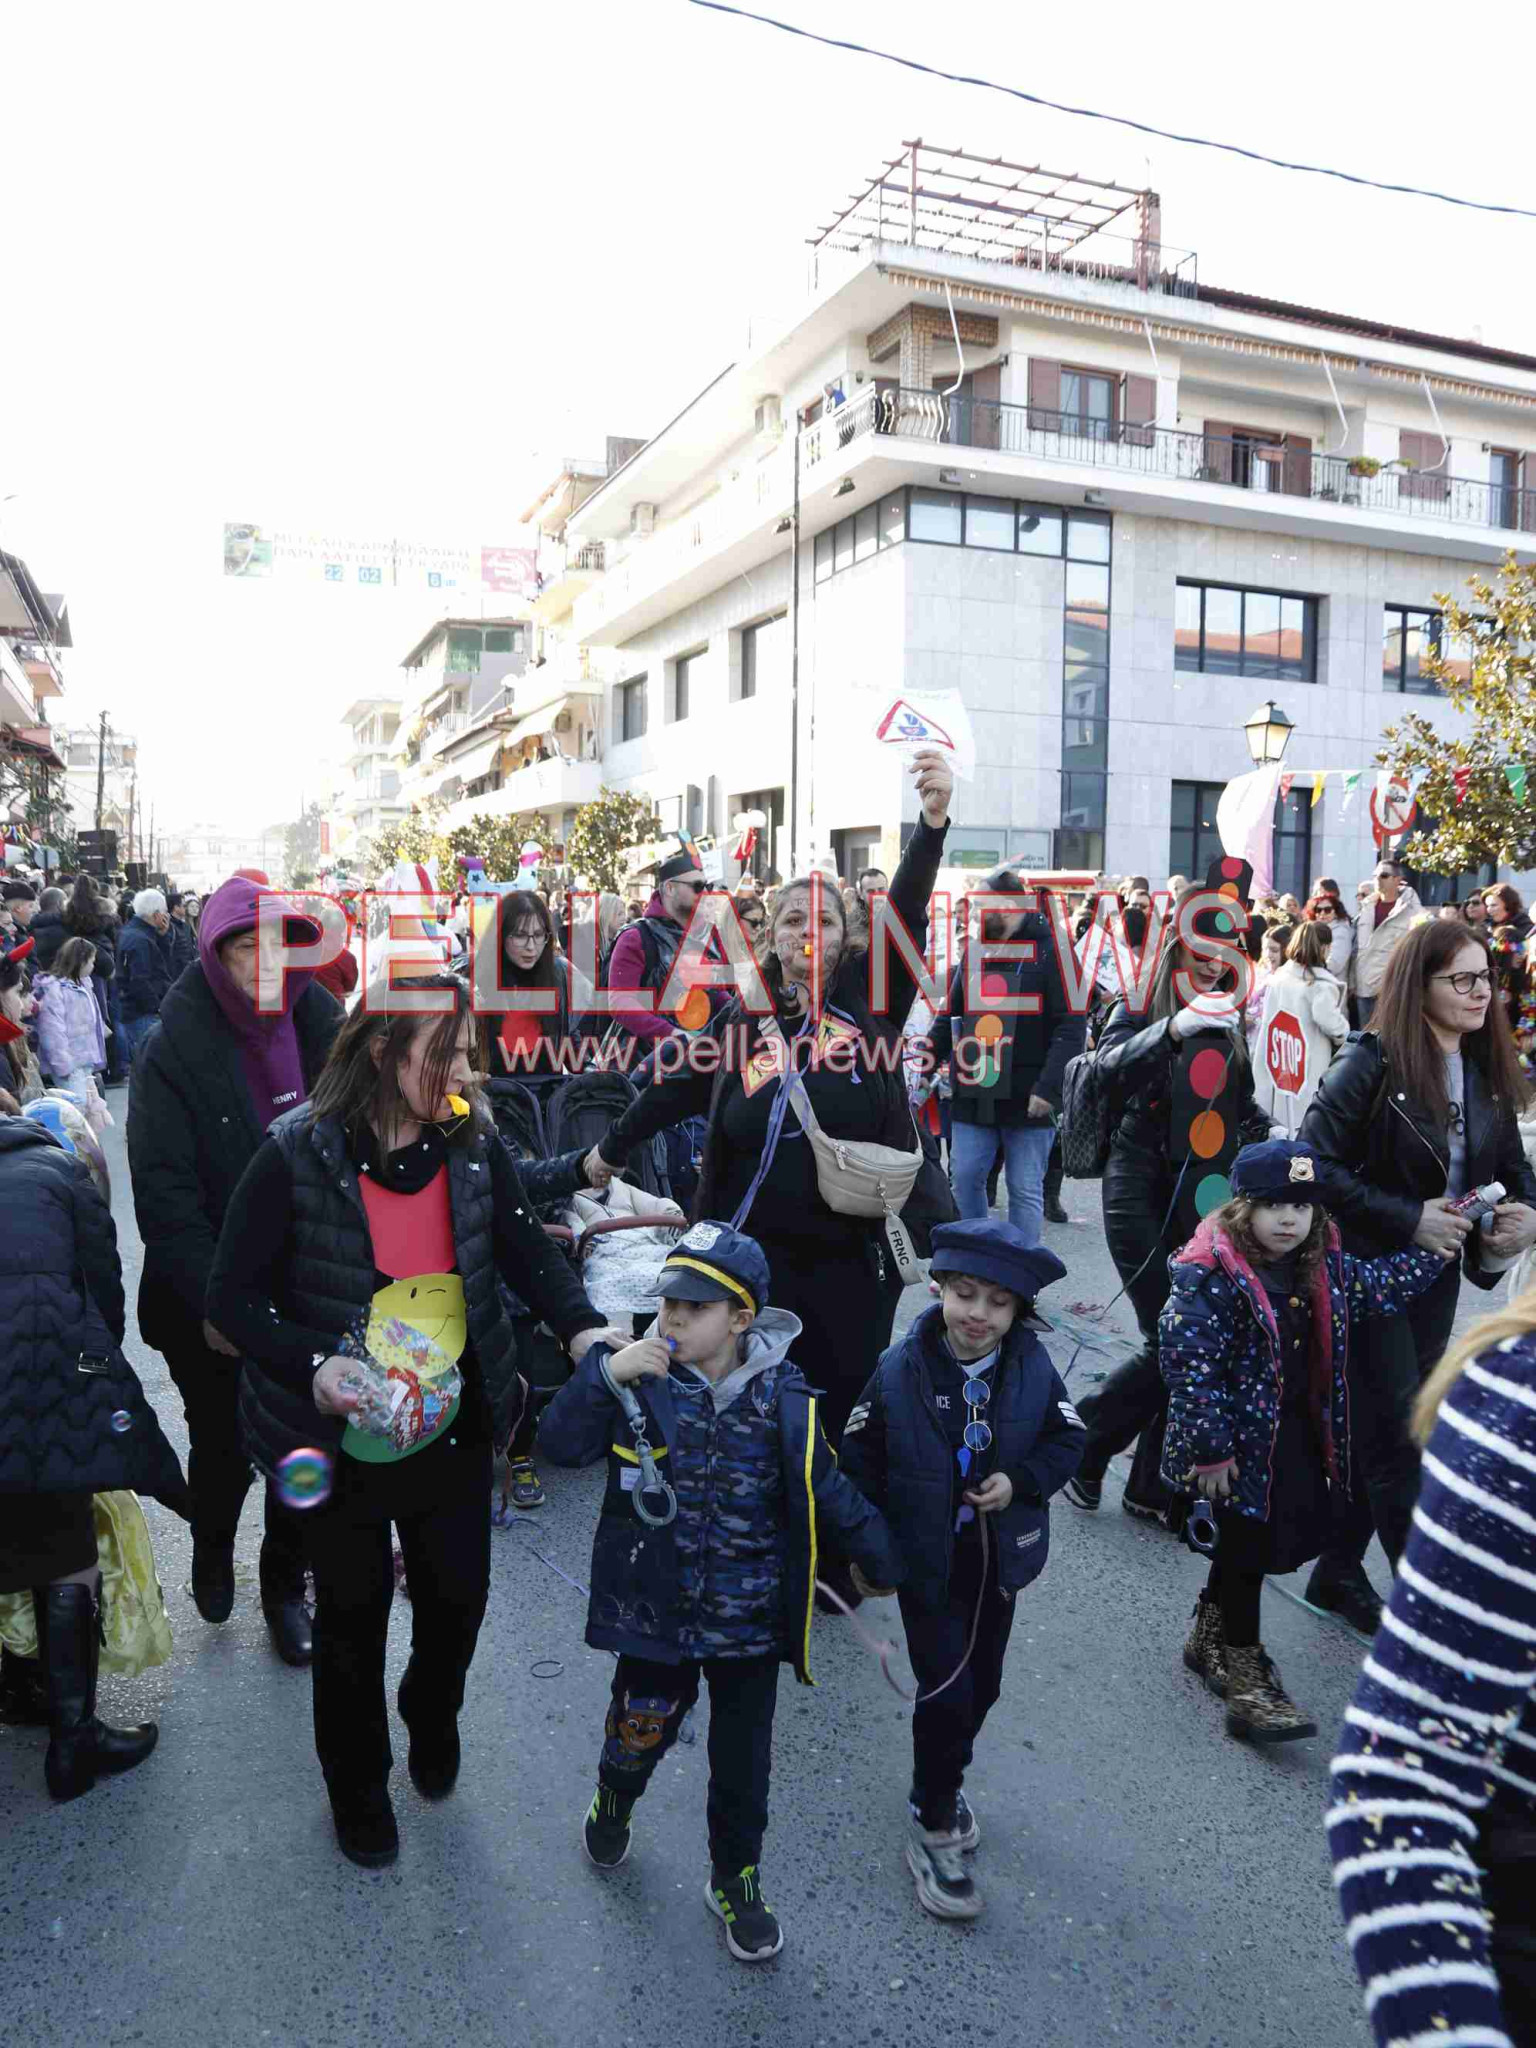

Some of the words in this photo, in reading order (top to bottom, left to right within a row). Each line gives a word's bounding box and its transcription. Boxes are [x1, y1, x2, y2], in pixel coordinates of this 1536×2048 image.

[325, 565, 343, 581] 22
[360, 569, 379, 582] 02
[1271, 1026, 1302, 1078] STOP
[271, 1090, 297, 1105] HENRY
[890, 1229, 910, 1266] FRNC
